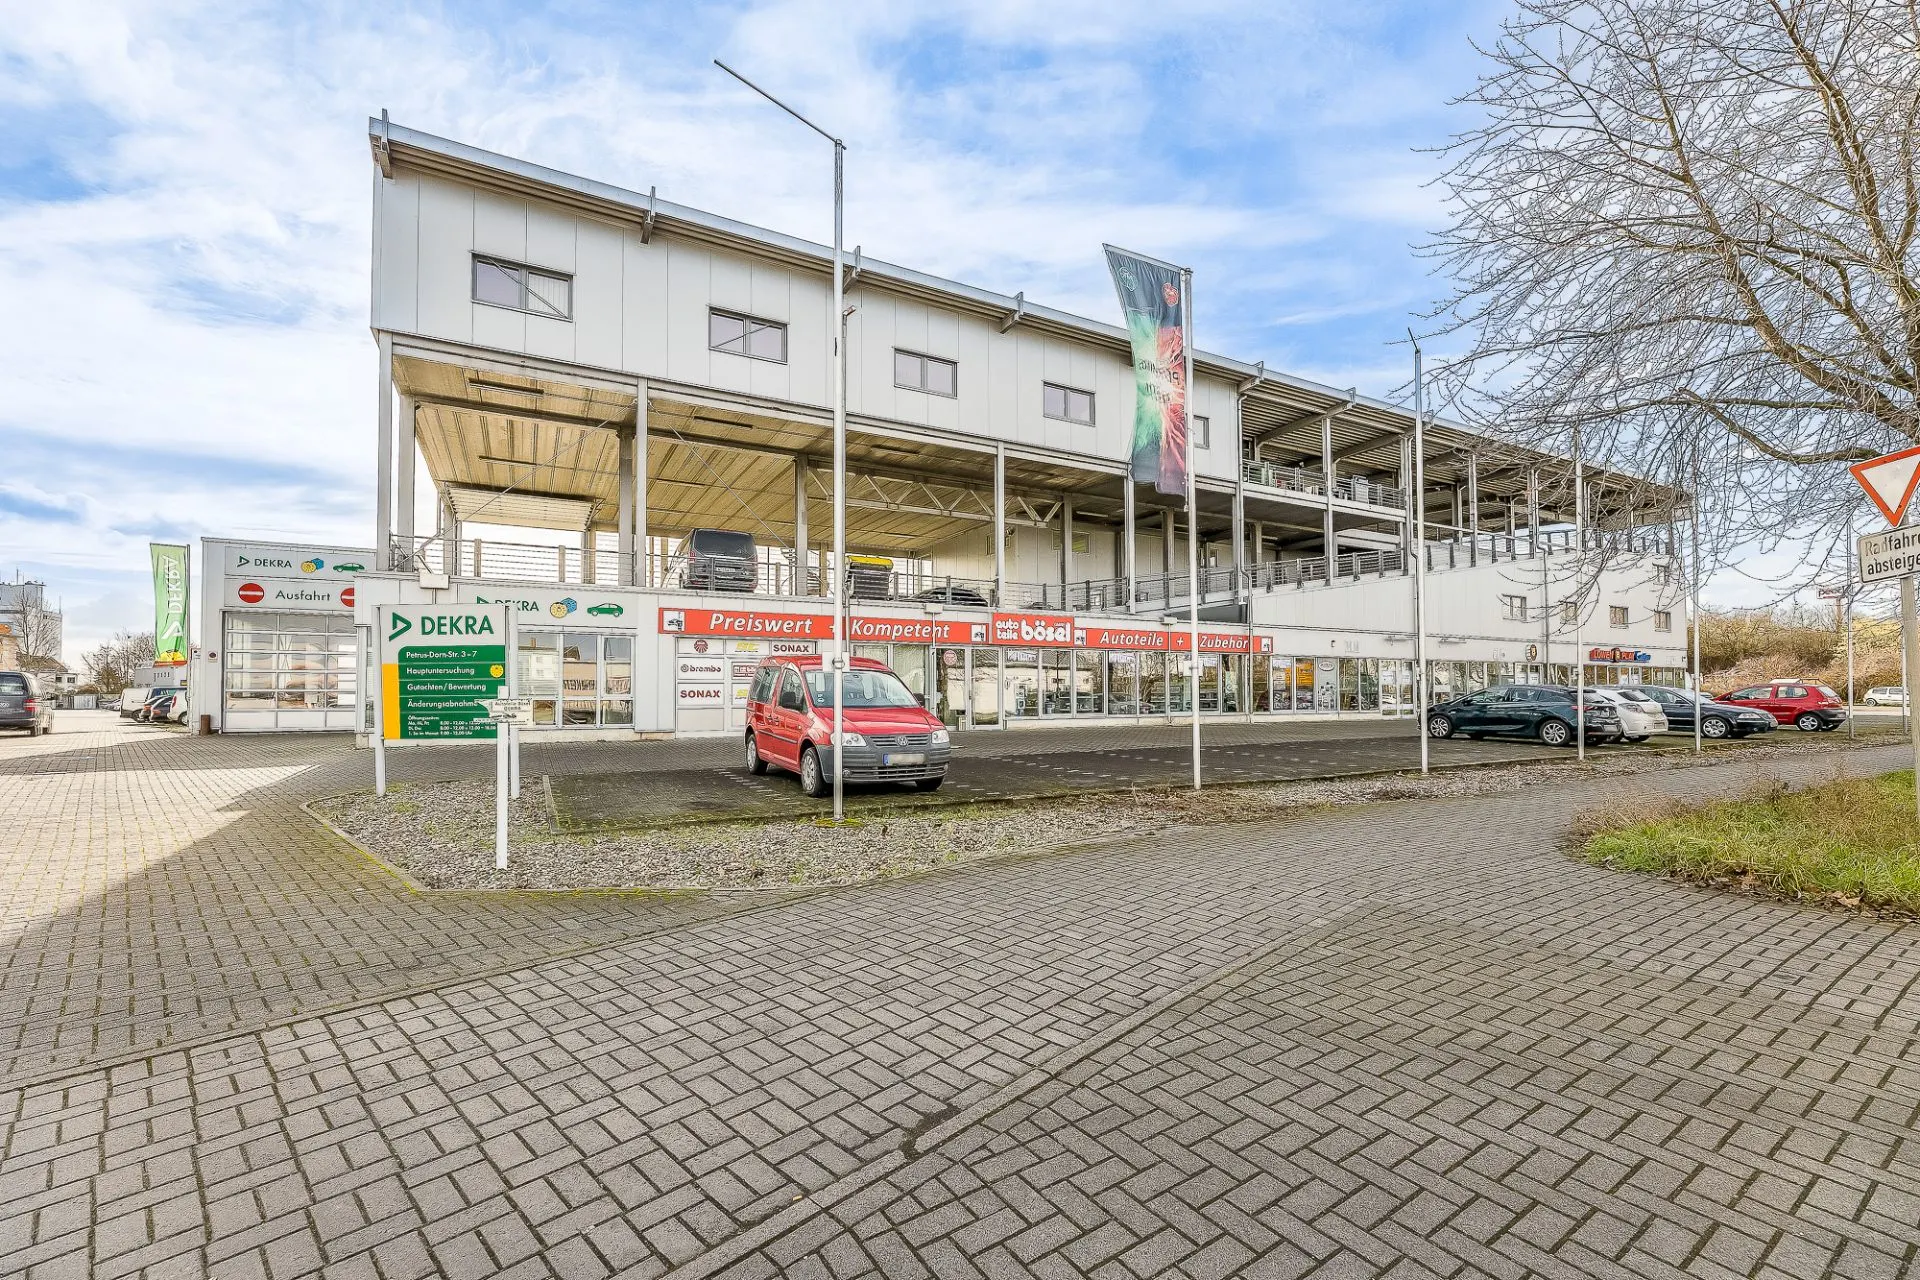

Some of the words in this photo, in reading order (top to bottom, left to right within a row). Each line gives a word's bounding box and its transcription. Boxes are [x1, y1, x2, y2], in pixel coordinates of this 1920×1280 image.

[254, 558, 292, 568] DEKRA
[275, 590, 331, 601] Ausfahrt
[421, 614, 494, 636] DEKRA
[709, 612, 812, 633] Preiswert
[851, 619, 950, 640] Kompetent
[995, 618, 1019, 630] auto
[1021, 619, 1071, 642] bösel
[1100, 631, 1164, 647] Autoteile
[1200, 635, 1249, 649] Zubehör
[773, 644, 810, 653] SONAX
[406, 667, 475, 676] Hauptuntersuchung
[689, 665, 721, 673] brembo
[407, 683, 443, 691] Gutachten
[448, 683, 487, 692] Bewertung
[680, 690, 721, 698] SONAX
